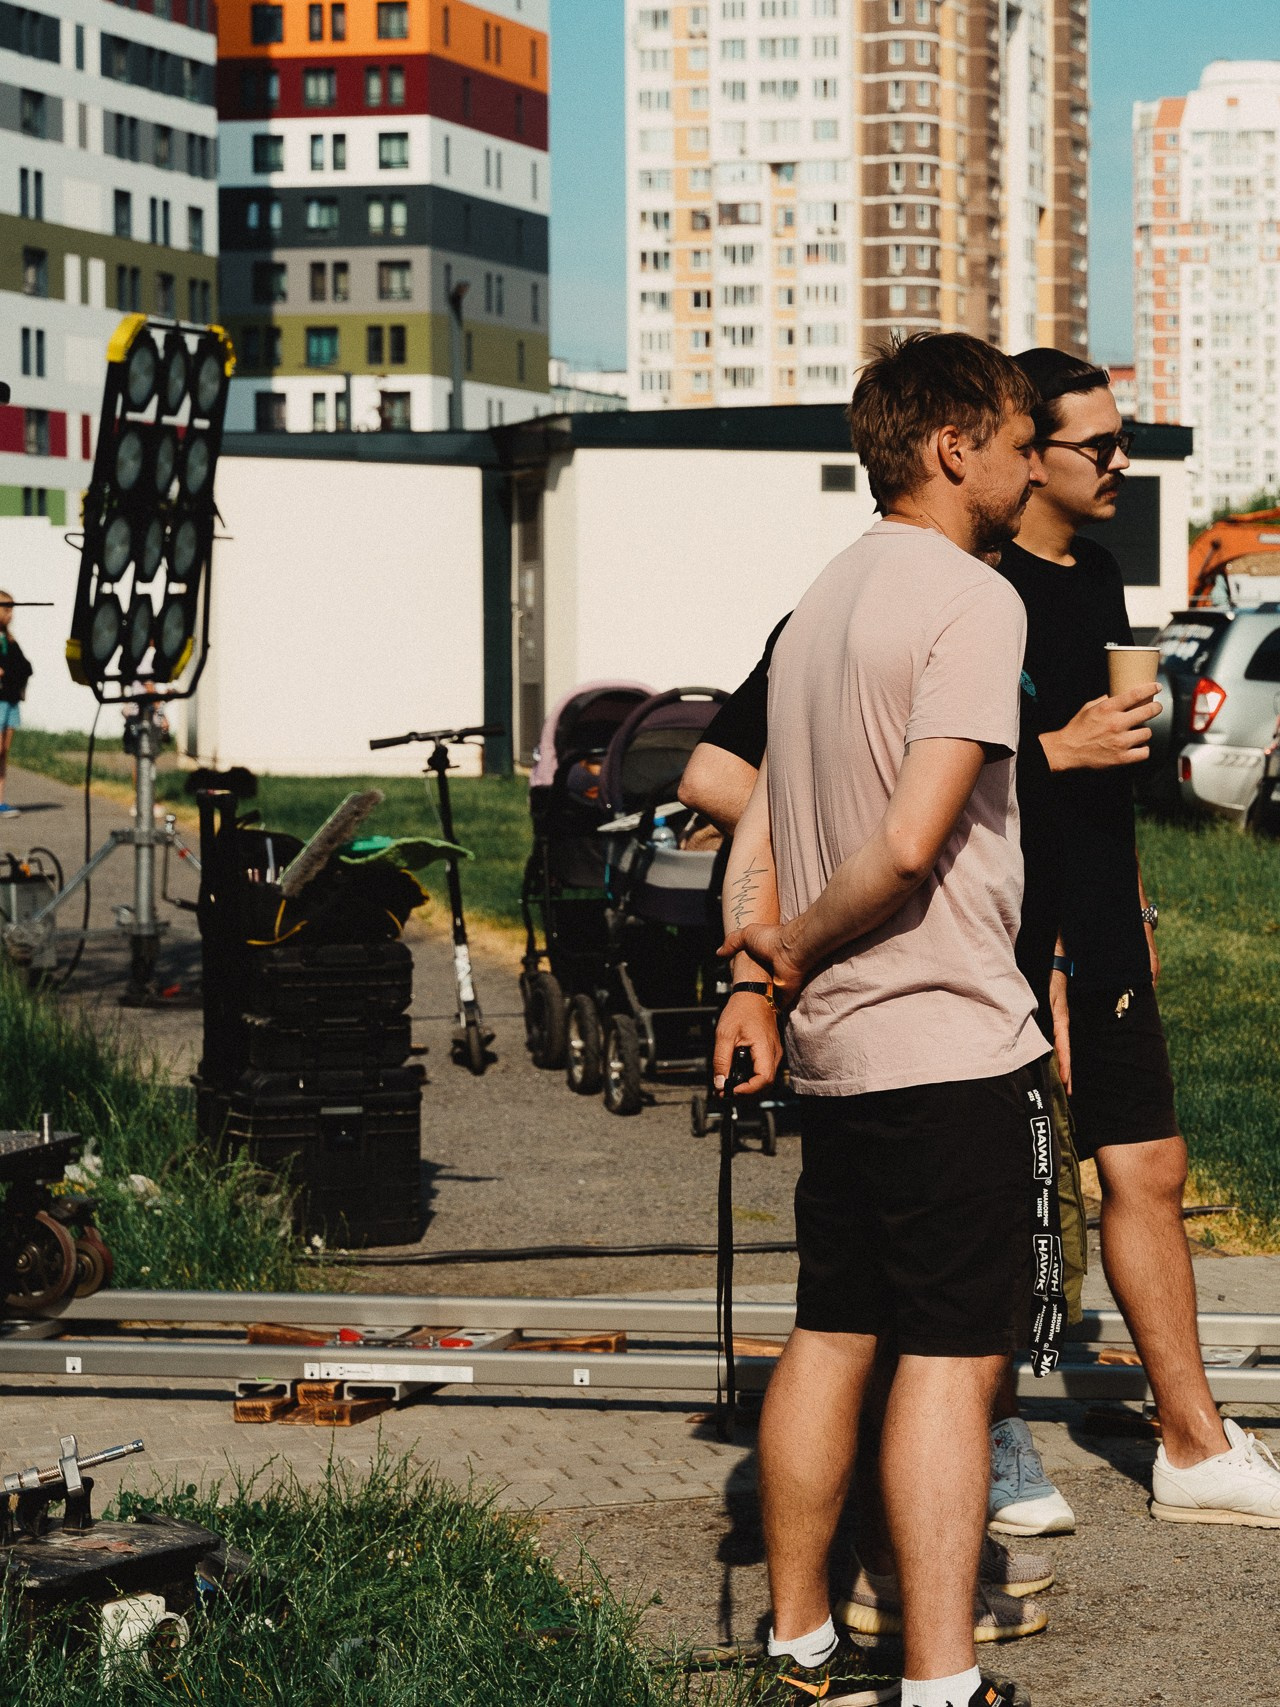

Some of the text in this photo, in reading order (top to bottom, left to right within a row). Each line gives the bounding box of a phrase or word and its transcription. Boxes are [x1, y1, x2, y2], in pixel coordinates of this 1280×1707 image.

[1035, 1121, 1048, 1175] HAWK
[1036, 1239, 1049, 1291] HAWK
[1048, 1303, 1058, 1342] ANAMORPHIC
